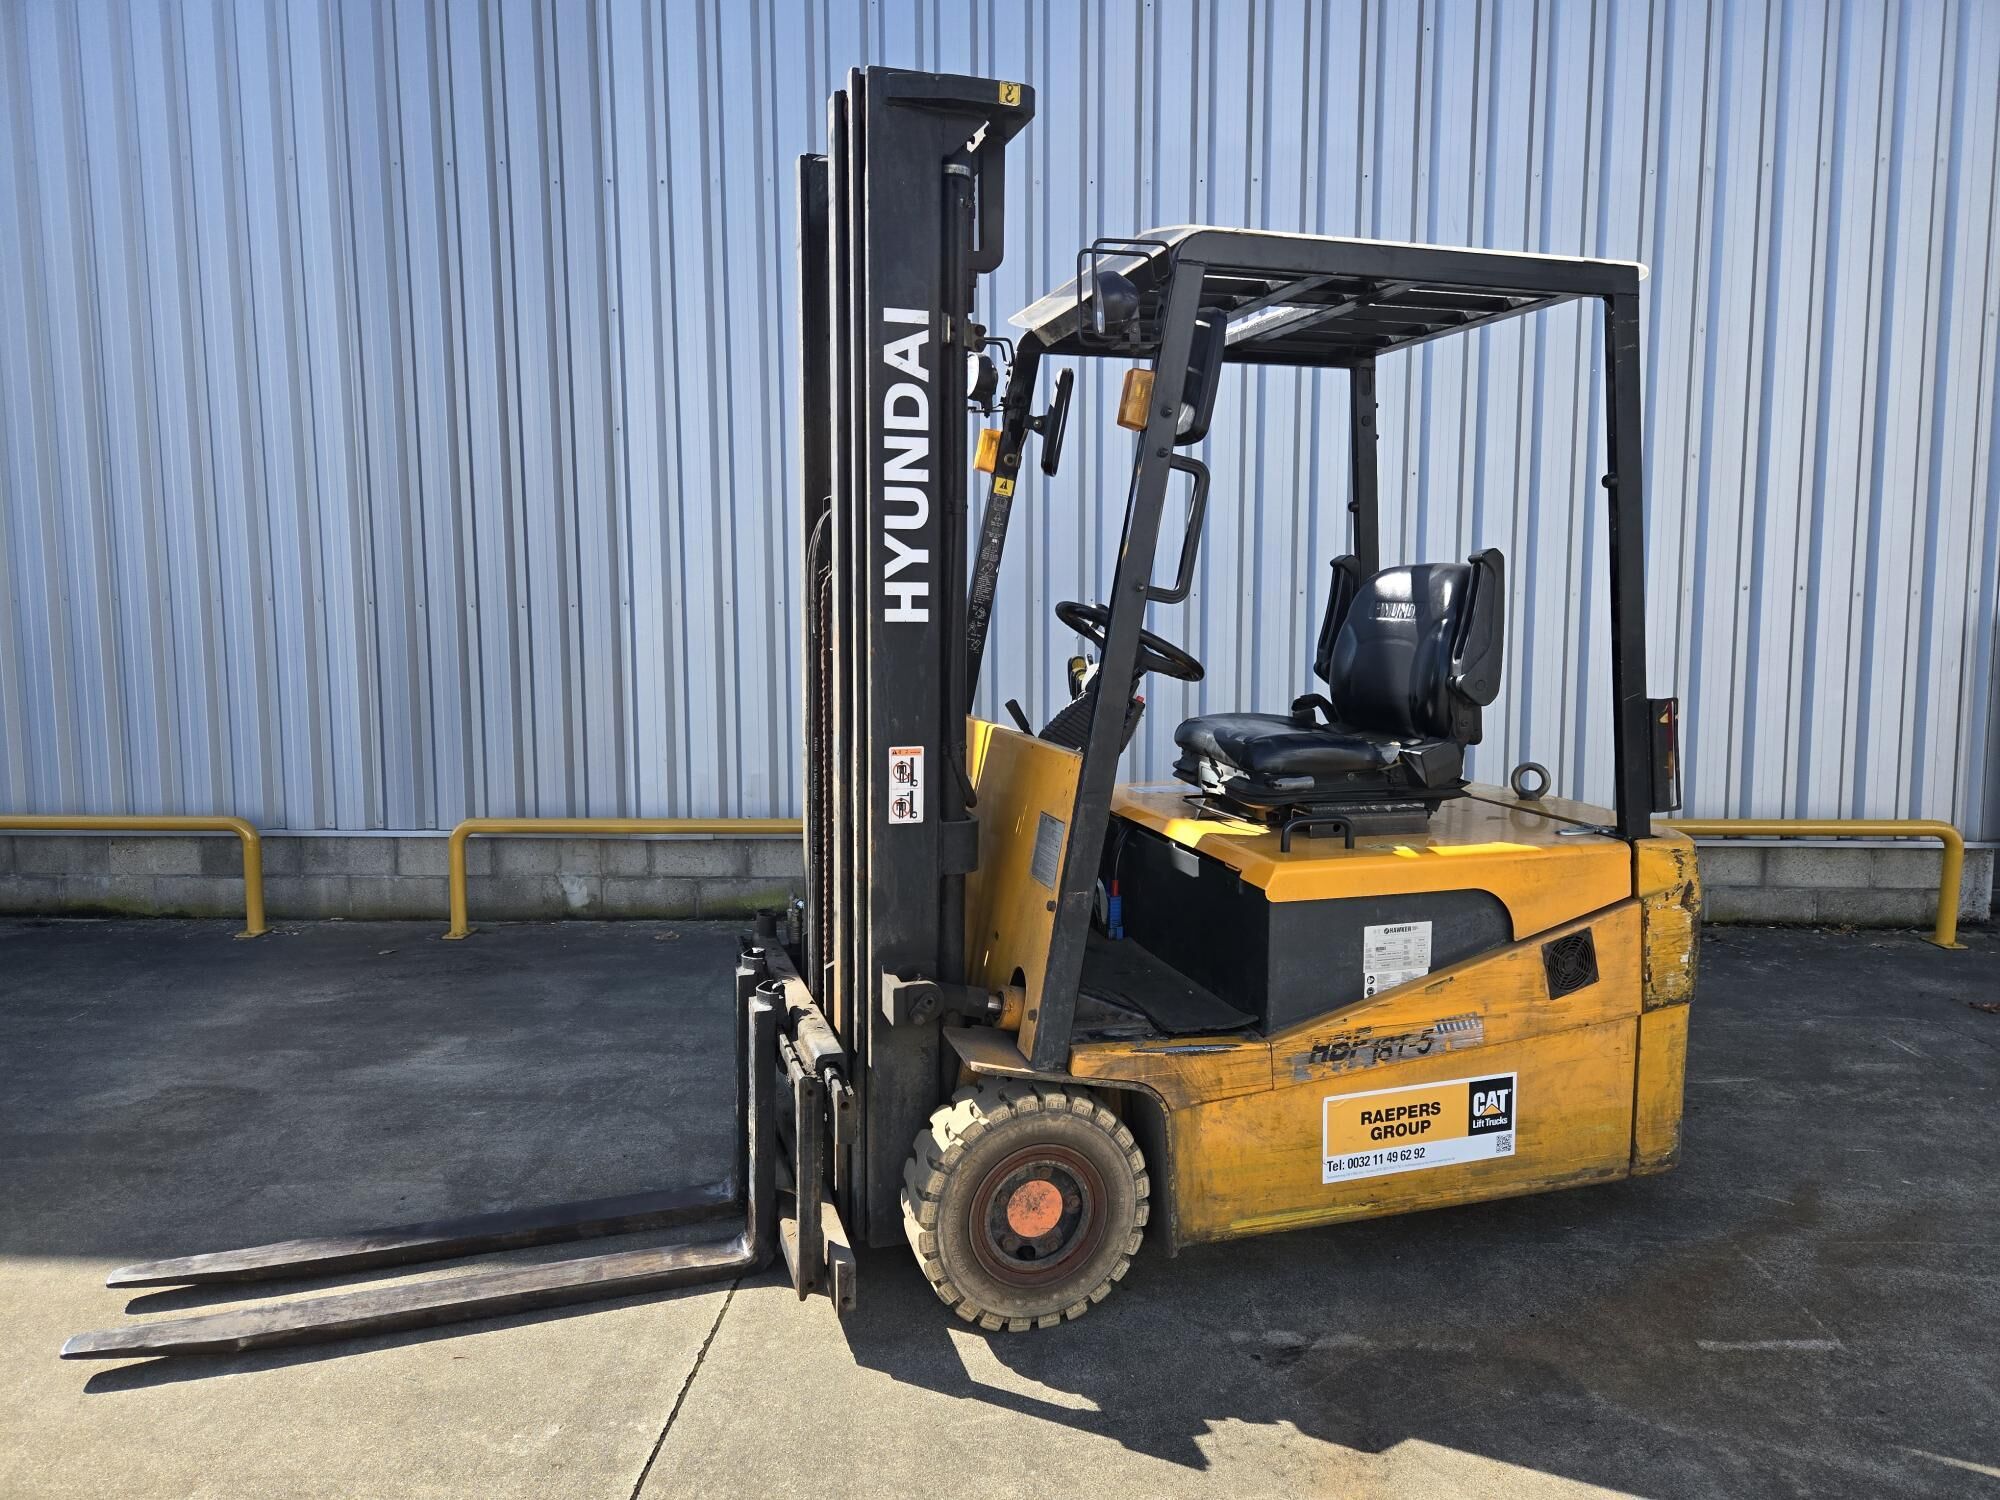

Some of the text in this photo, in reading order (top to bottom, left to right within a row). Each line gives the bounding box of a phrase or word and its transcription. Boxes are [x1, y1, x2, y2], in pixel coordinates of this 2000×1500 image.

[883, 307, 929, 623] HYUNDAI
[1360, 1101, 1442, 1126] RAEPERS
[1473, 1088, 1509, 1117] CAT
[1370, 1119, 1432, 1141] GROUP
[1472, 1116, 1508, 1129] Lift Trucks
[1326, 1159, 1345, 1172] Tel:
[1347, 1155, 1371, 1169] 0032
[1374, 1154, 1383, 1166] 11
[1386, 1151, 1398, 1163] 49
[1400, 1149, 1412, 1161] 62
[1414, 1147, 1426, 1159] 92
